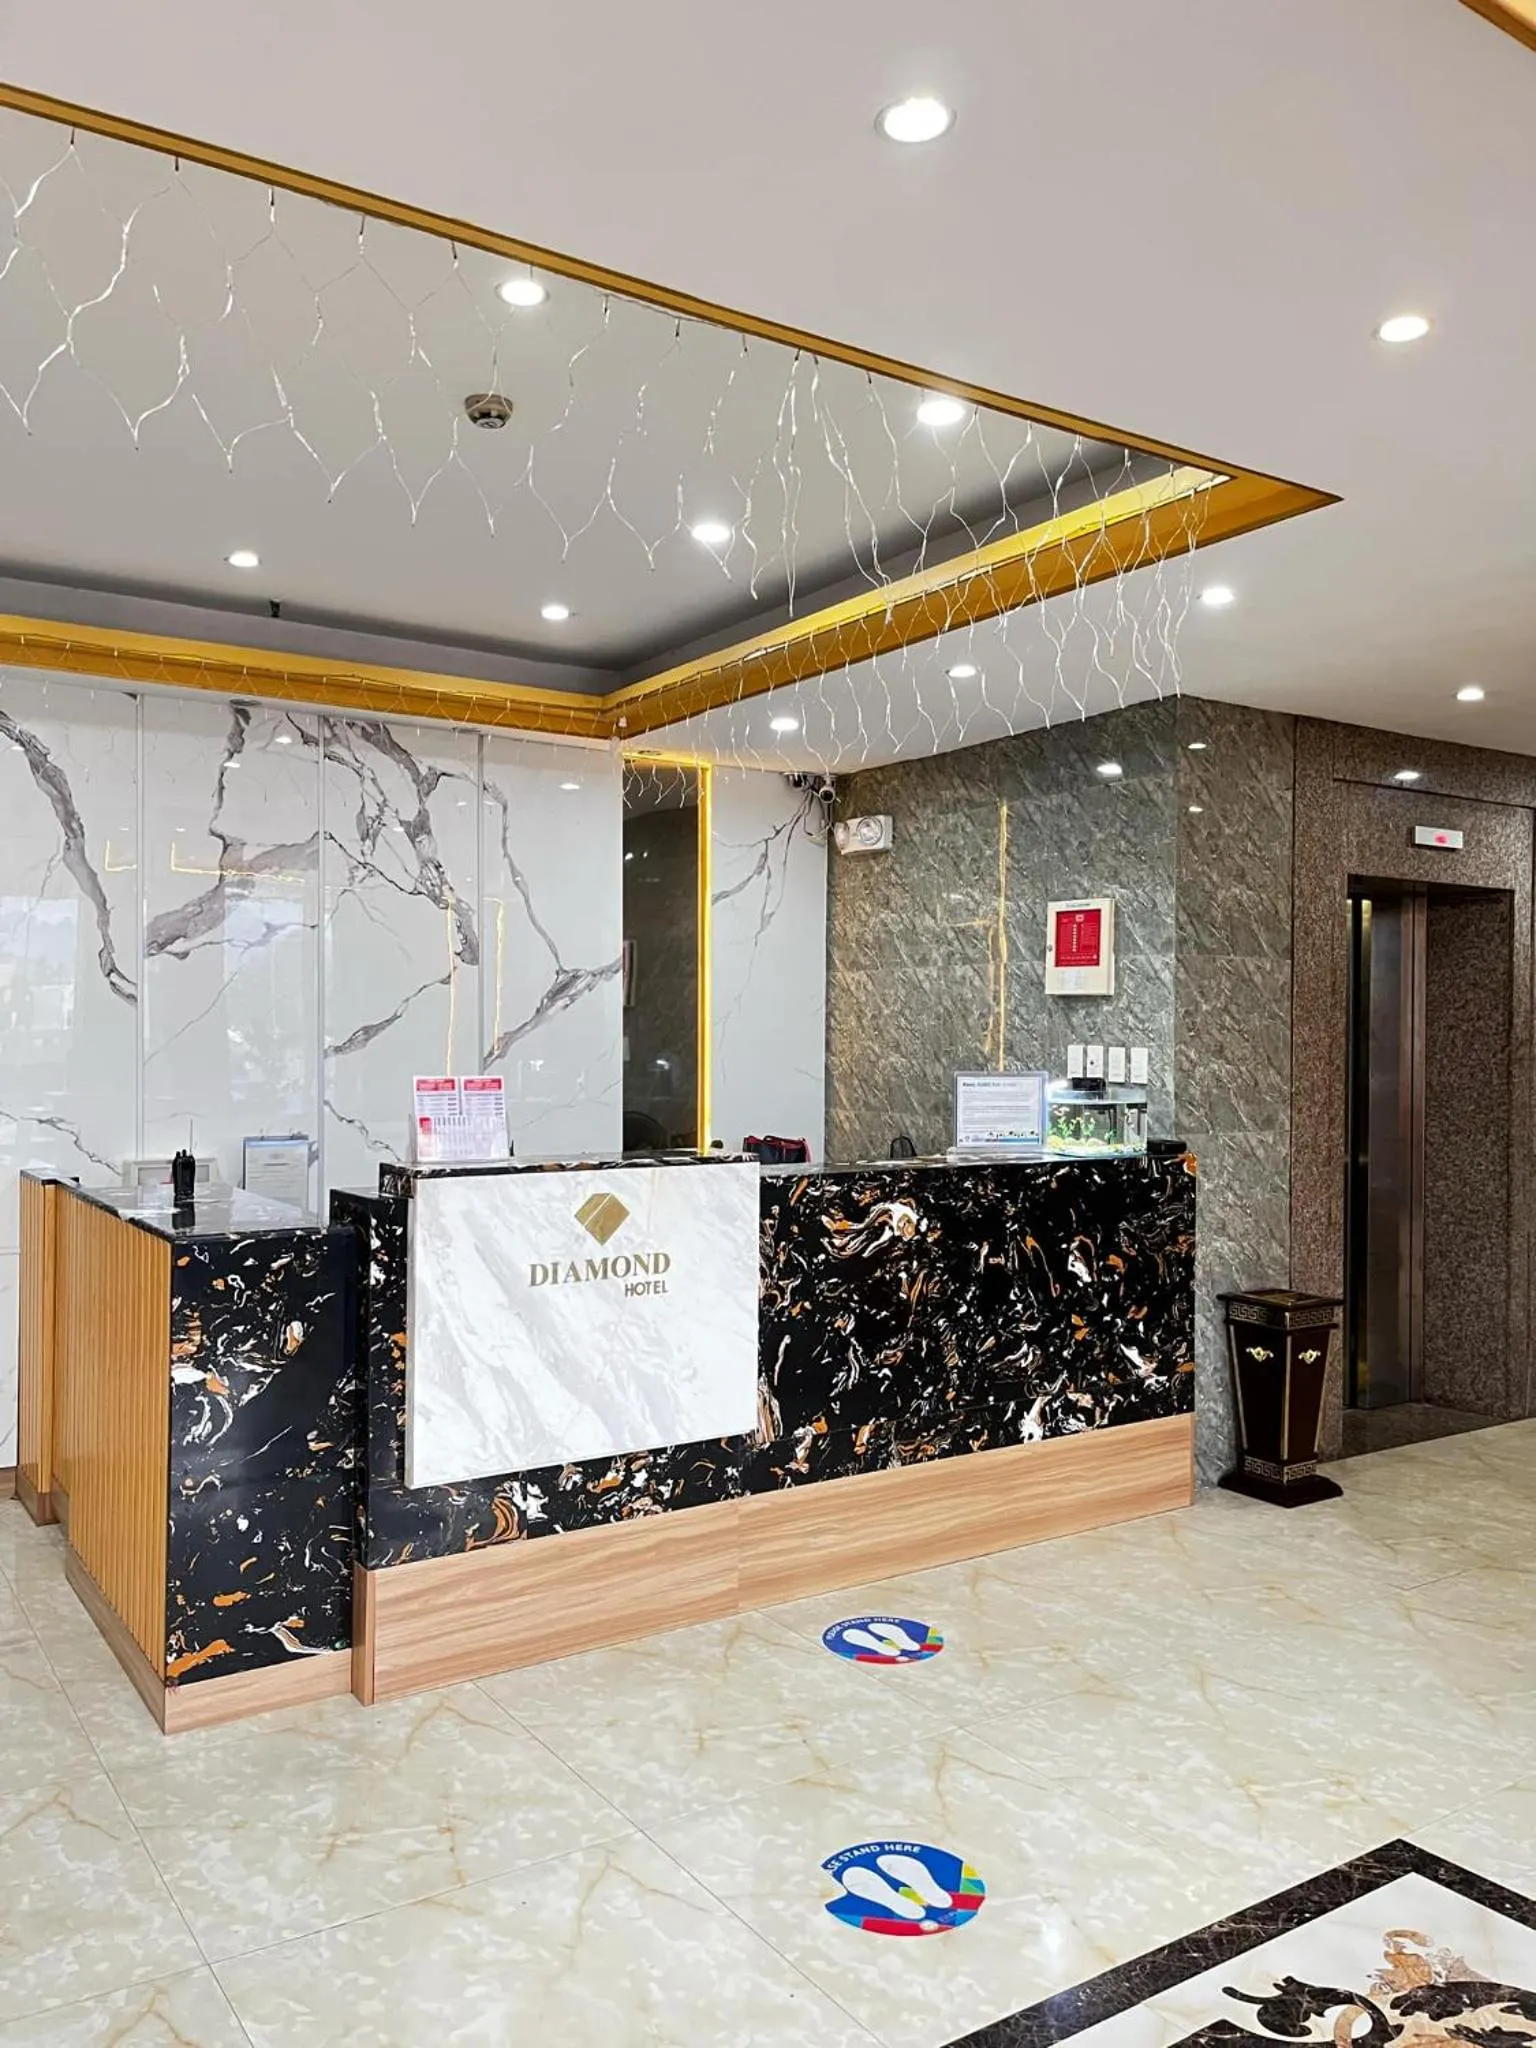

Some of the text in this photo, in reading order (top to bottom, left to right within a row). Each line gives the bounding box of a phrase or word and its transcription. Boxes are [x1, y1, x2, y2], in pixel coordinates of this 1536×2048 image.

[529, 1252, 671, 1287] DIAMOND
[624, 1280, 668, 1297] HOTEL
[839, 1845, 880, 1862] STAND
[884, 1843, 921, 1854] HERE
